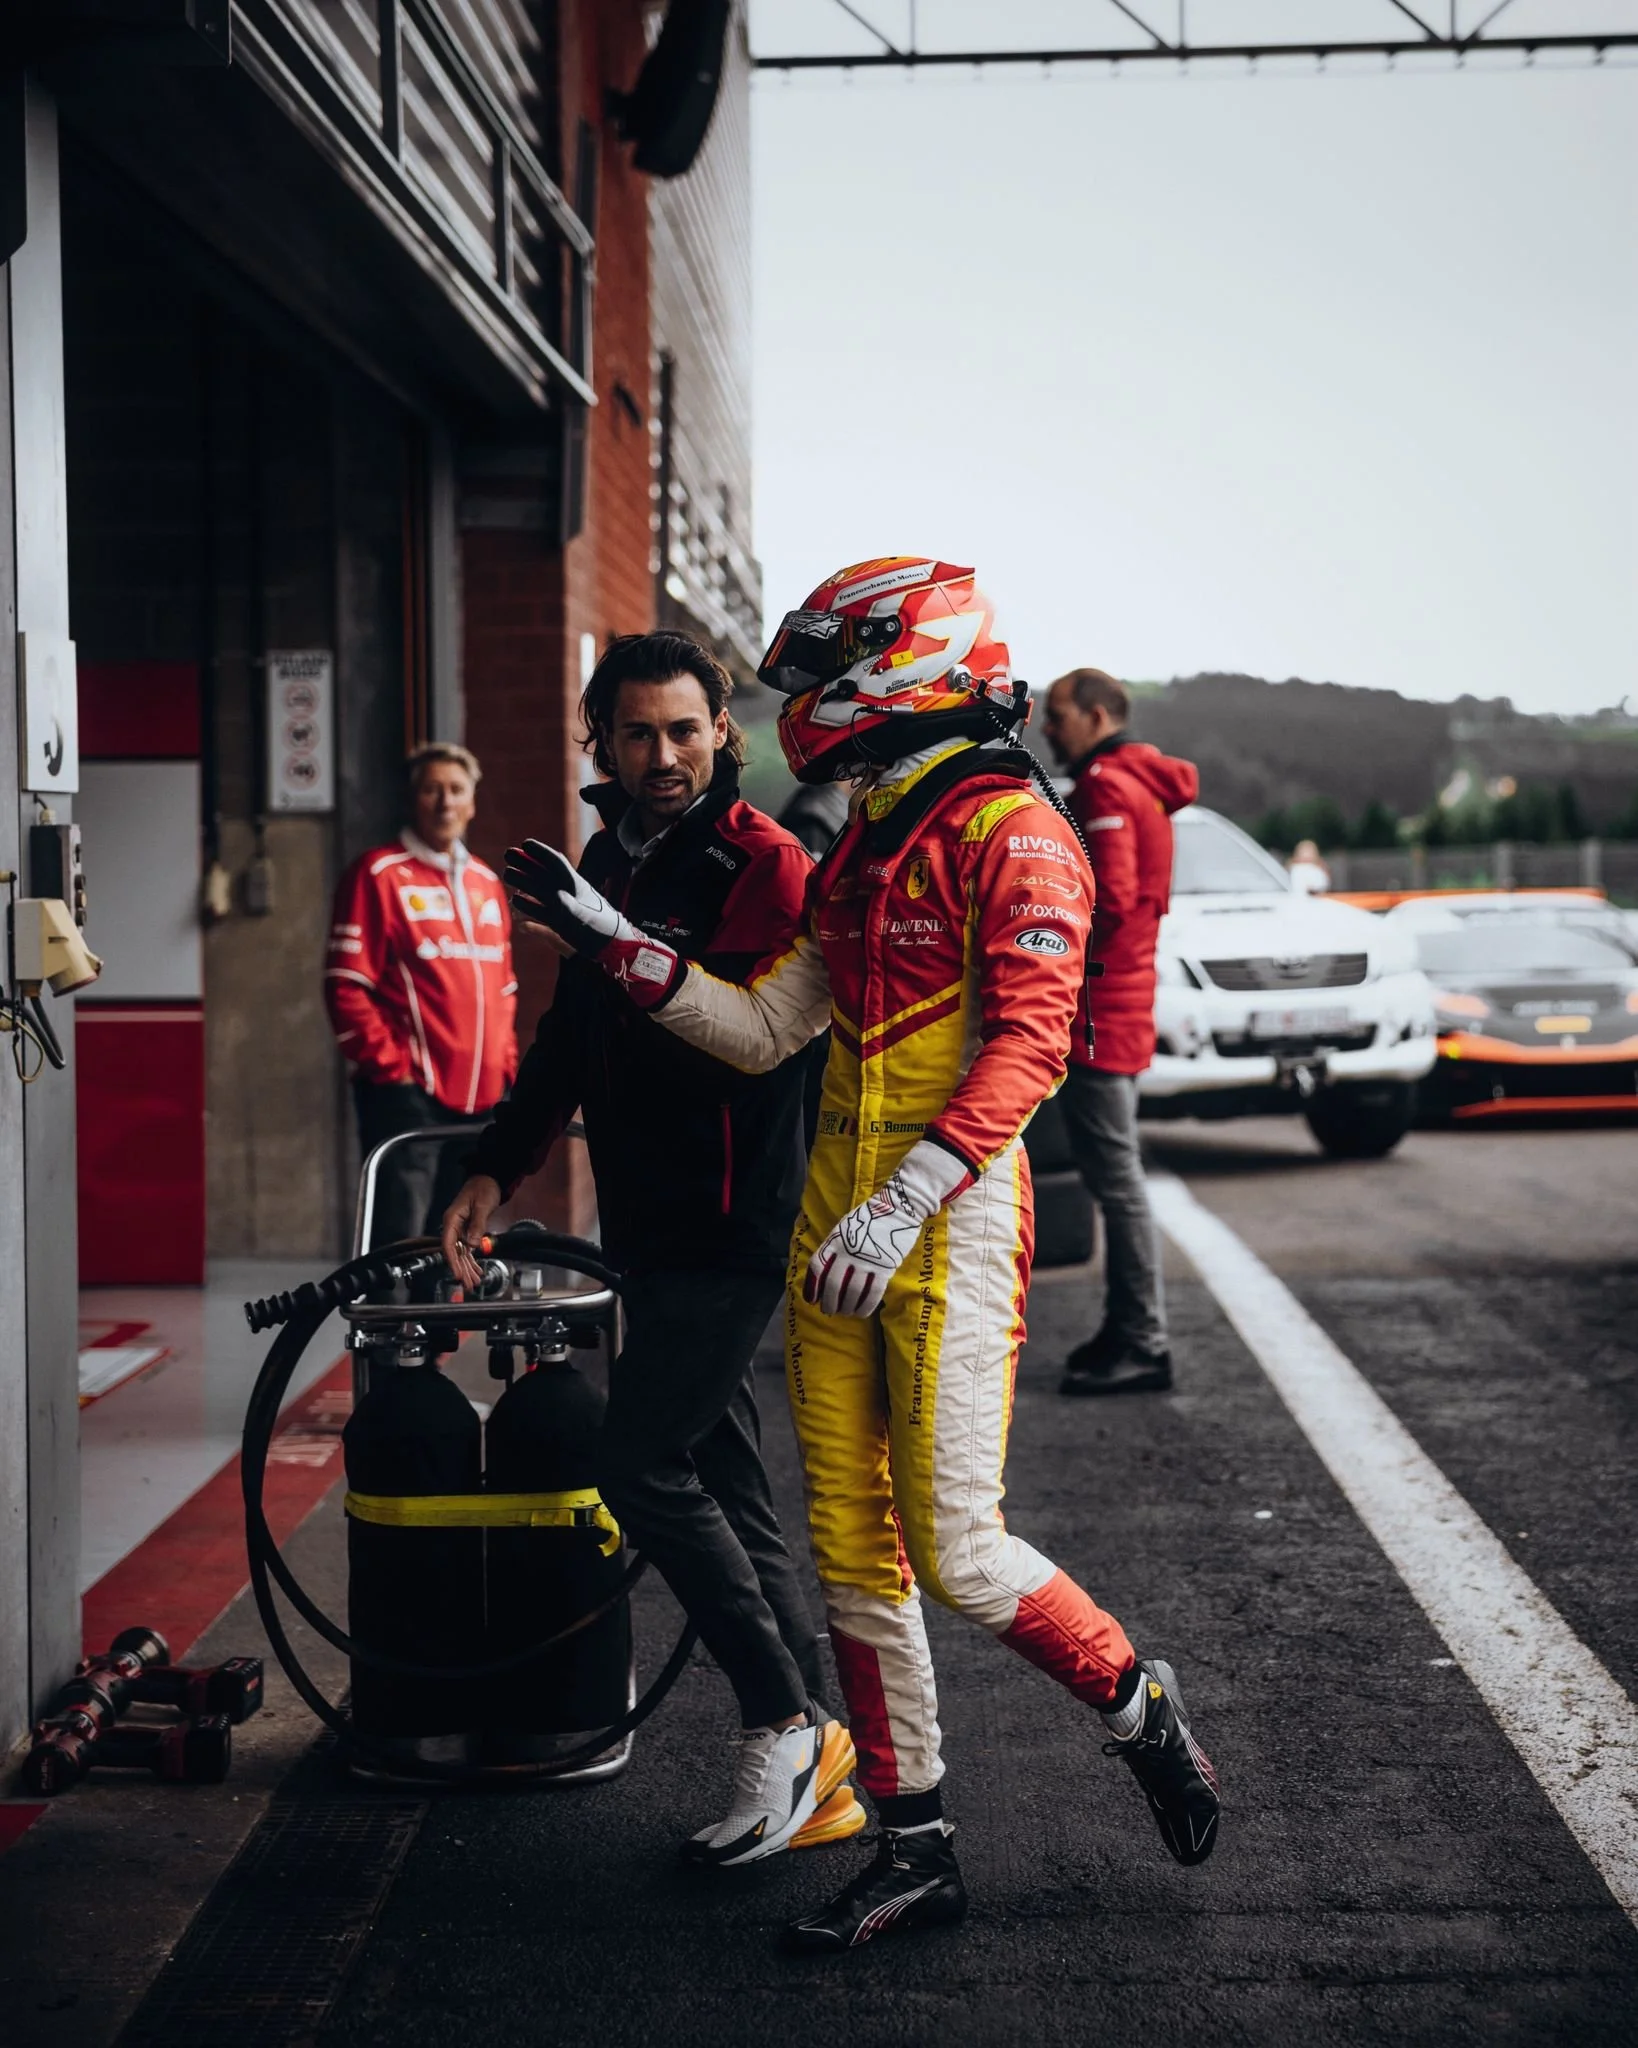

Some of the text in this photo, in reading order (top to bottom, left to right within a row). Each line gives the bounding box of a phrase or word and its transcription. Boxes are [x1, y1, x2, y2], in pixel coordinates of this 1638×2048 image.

[839, 572, 924, 601] Francorchamps Motors
[1010, 904, 1082, 925] IVY OXFORD
[1020, 932, 1062, 951] Arai
[909, 1224, 938, 1427] Francorchamps Motors
[790, 1341, 807, 1406] Motors
